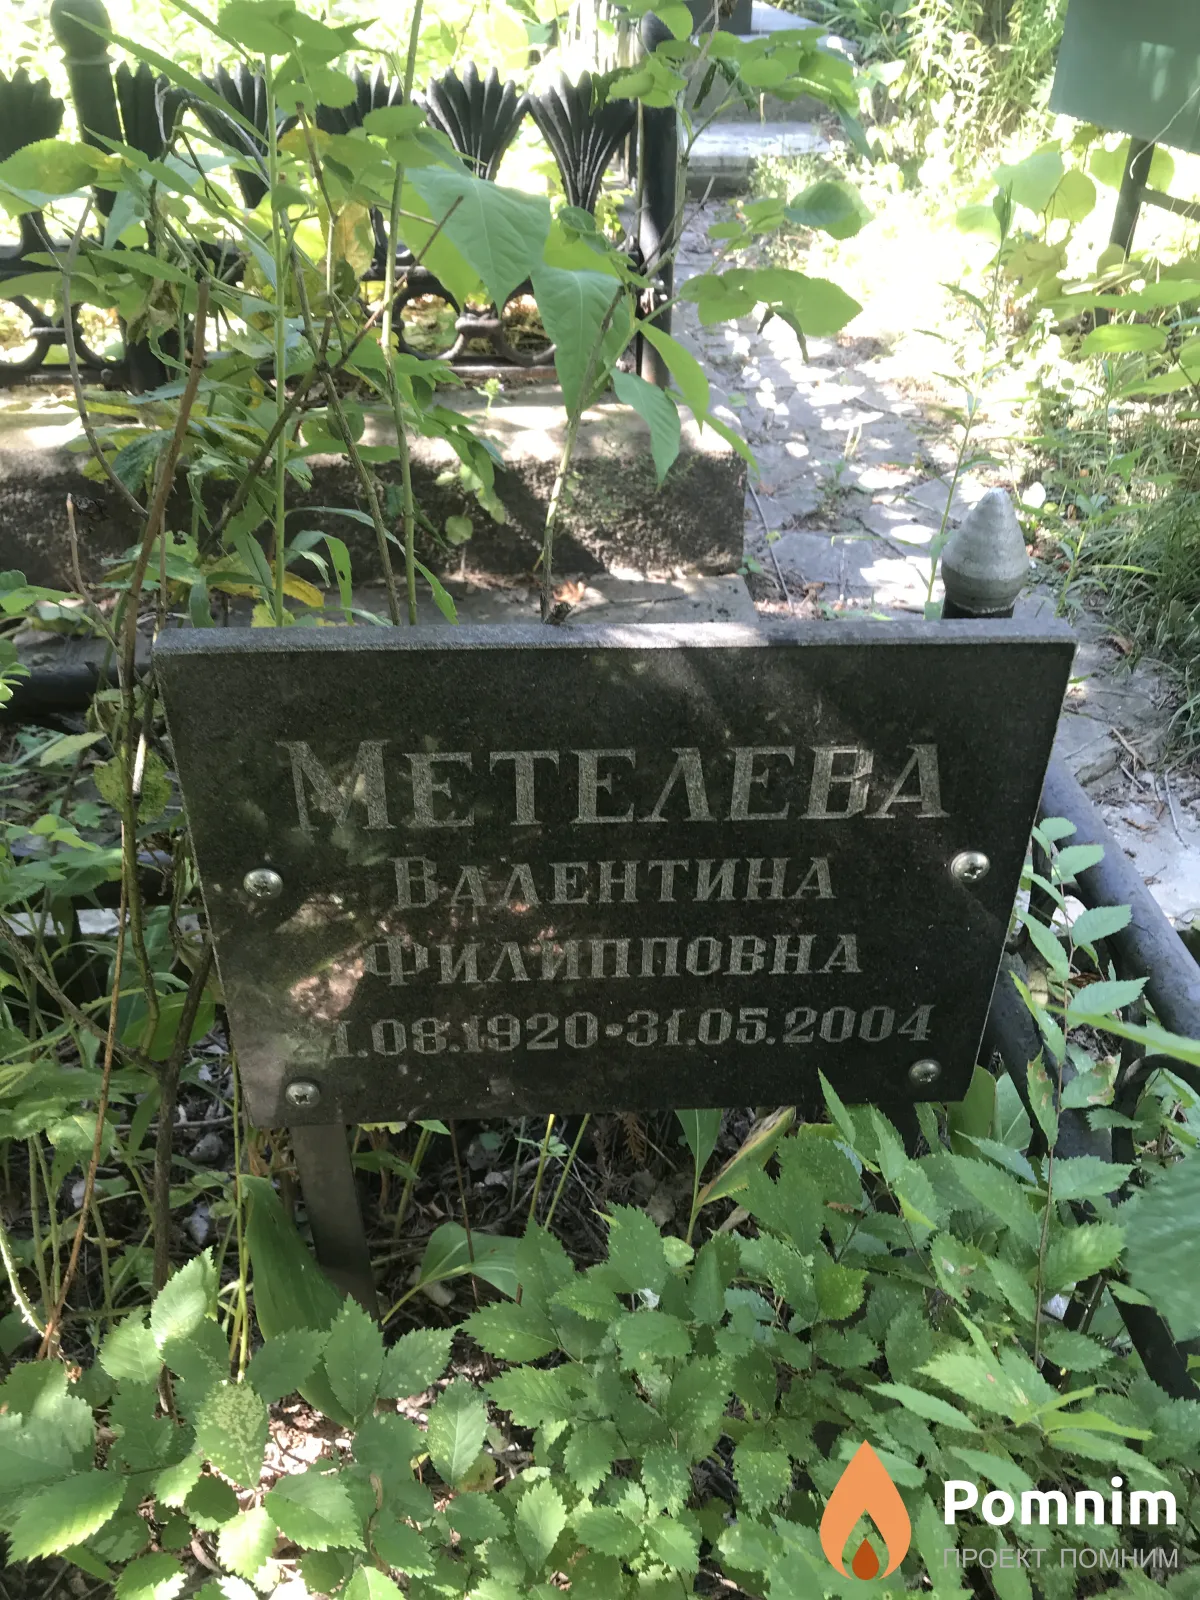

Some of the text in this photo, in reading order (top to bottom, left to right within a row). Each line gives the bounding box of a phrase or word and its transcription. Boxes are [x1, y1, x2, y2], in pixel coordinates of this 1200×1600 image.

[275, 739, 950, 831] МЕТЕЛЕВА
[388, 856, 838, 908] ВАЛЕНТИНА
[364, 933, 863, 987] ФИЛИППОВНА
